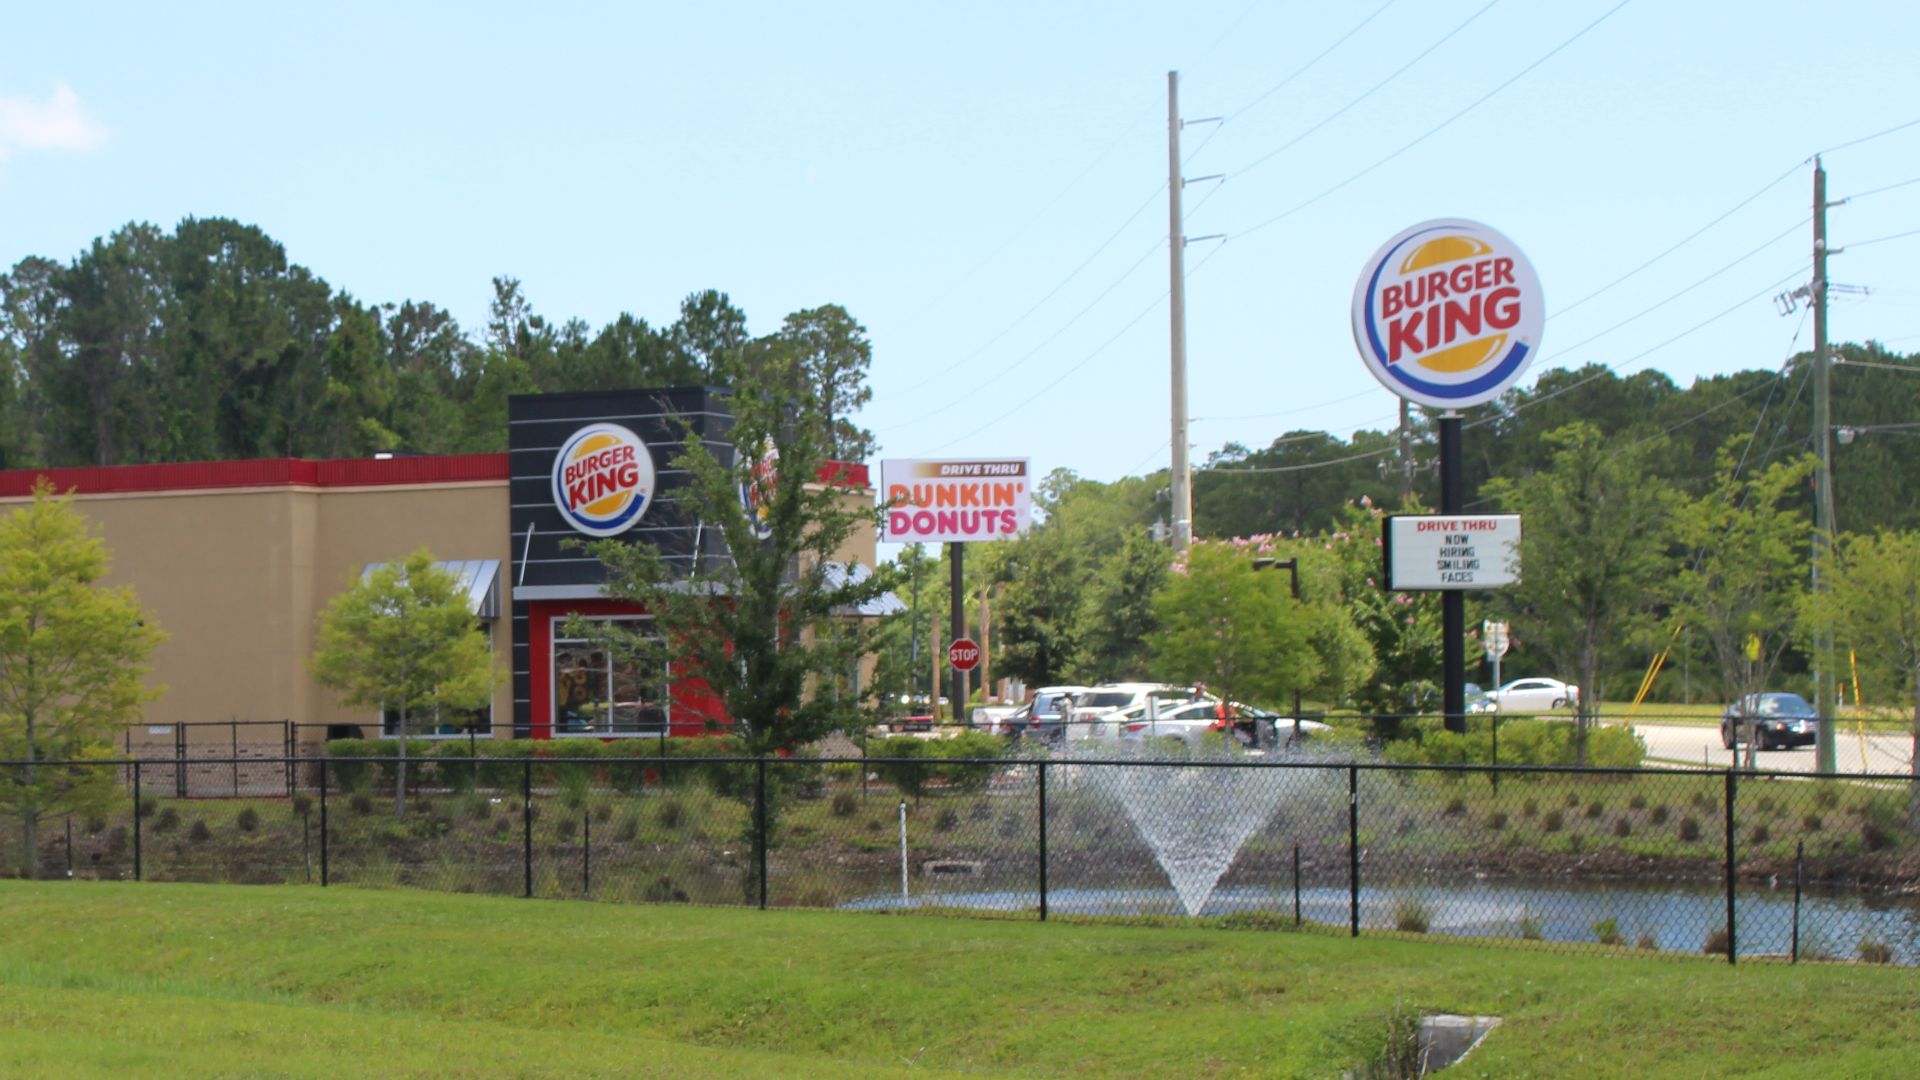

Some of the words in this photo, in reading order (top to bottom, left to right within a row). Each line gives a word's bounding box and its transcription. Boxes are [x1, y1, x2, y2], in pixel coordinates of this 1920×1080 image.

[1382, 257, 1516, 320] BURGER
[1388, 286, 1521, 364] KING
[565, 445, 635, 486] BURGER
[941, 463, 981, 475] DRIVE
[983, 463, 1020, 475] THRU
[569, 463, 639, 512] KING
[889, 482, 1024, 508] DUNKIN'
[889, 509, 1018, 536] DONUTS
[1417, 521, 1457, 532] DRIVE
[1462, 520, 1497, 531] THRU
[1445, 534, 1469, 545] NOW
[1440, 546, 1475, 558] HIRING
[1437, 559, 1480, 570] SMILING
[1441, 571, 1474, 583] FACES
[950, 648, 978, 662] STOP
